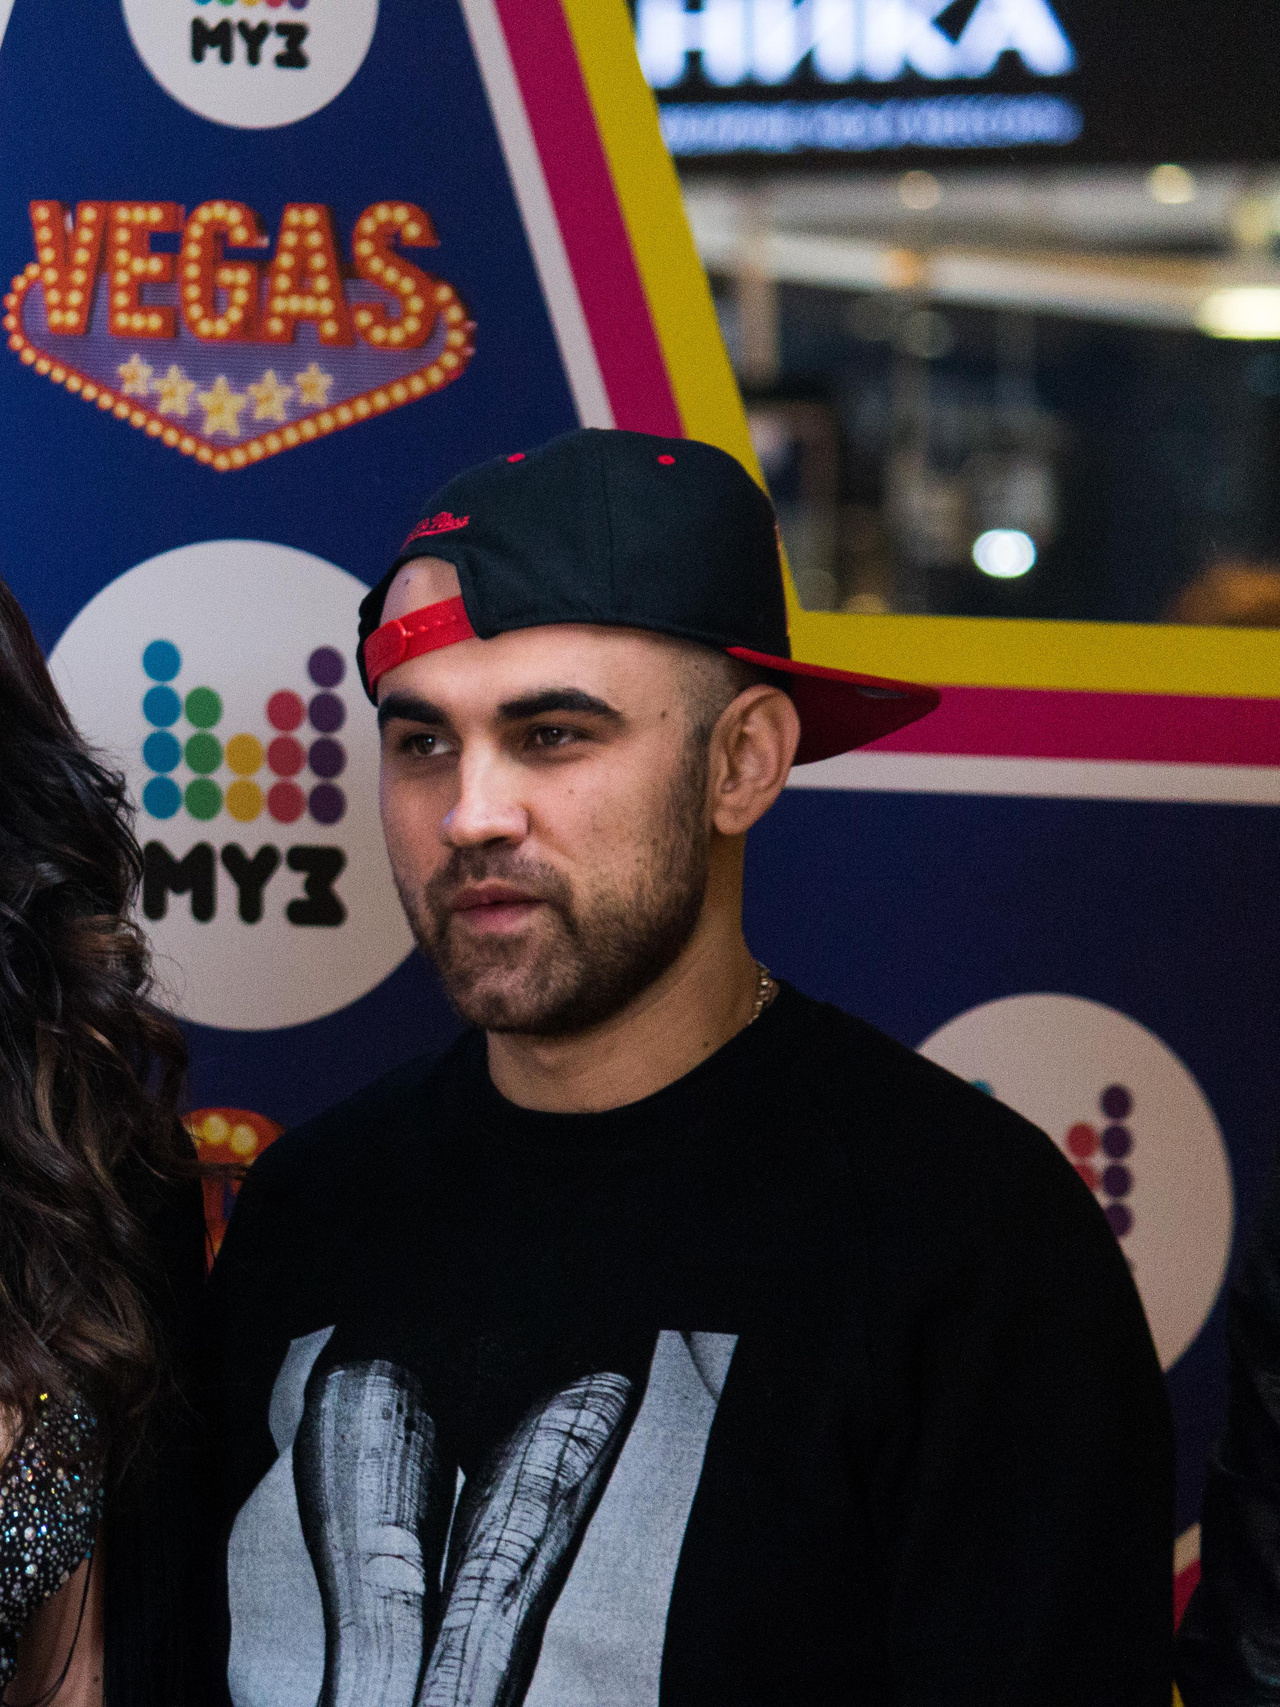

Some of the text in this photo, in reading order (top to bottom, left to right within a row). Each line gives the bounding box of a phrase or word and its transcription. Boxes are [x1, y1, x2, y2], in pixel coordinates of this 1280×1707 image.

[190, 16, 310, 69] МУЗ
[29, 199, 441, 349] VEGAS
[141, 839, 348, 928] МУЗ
